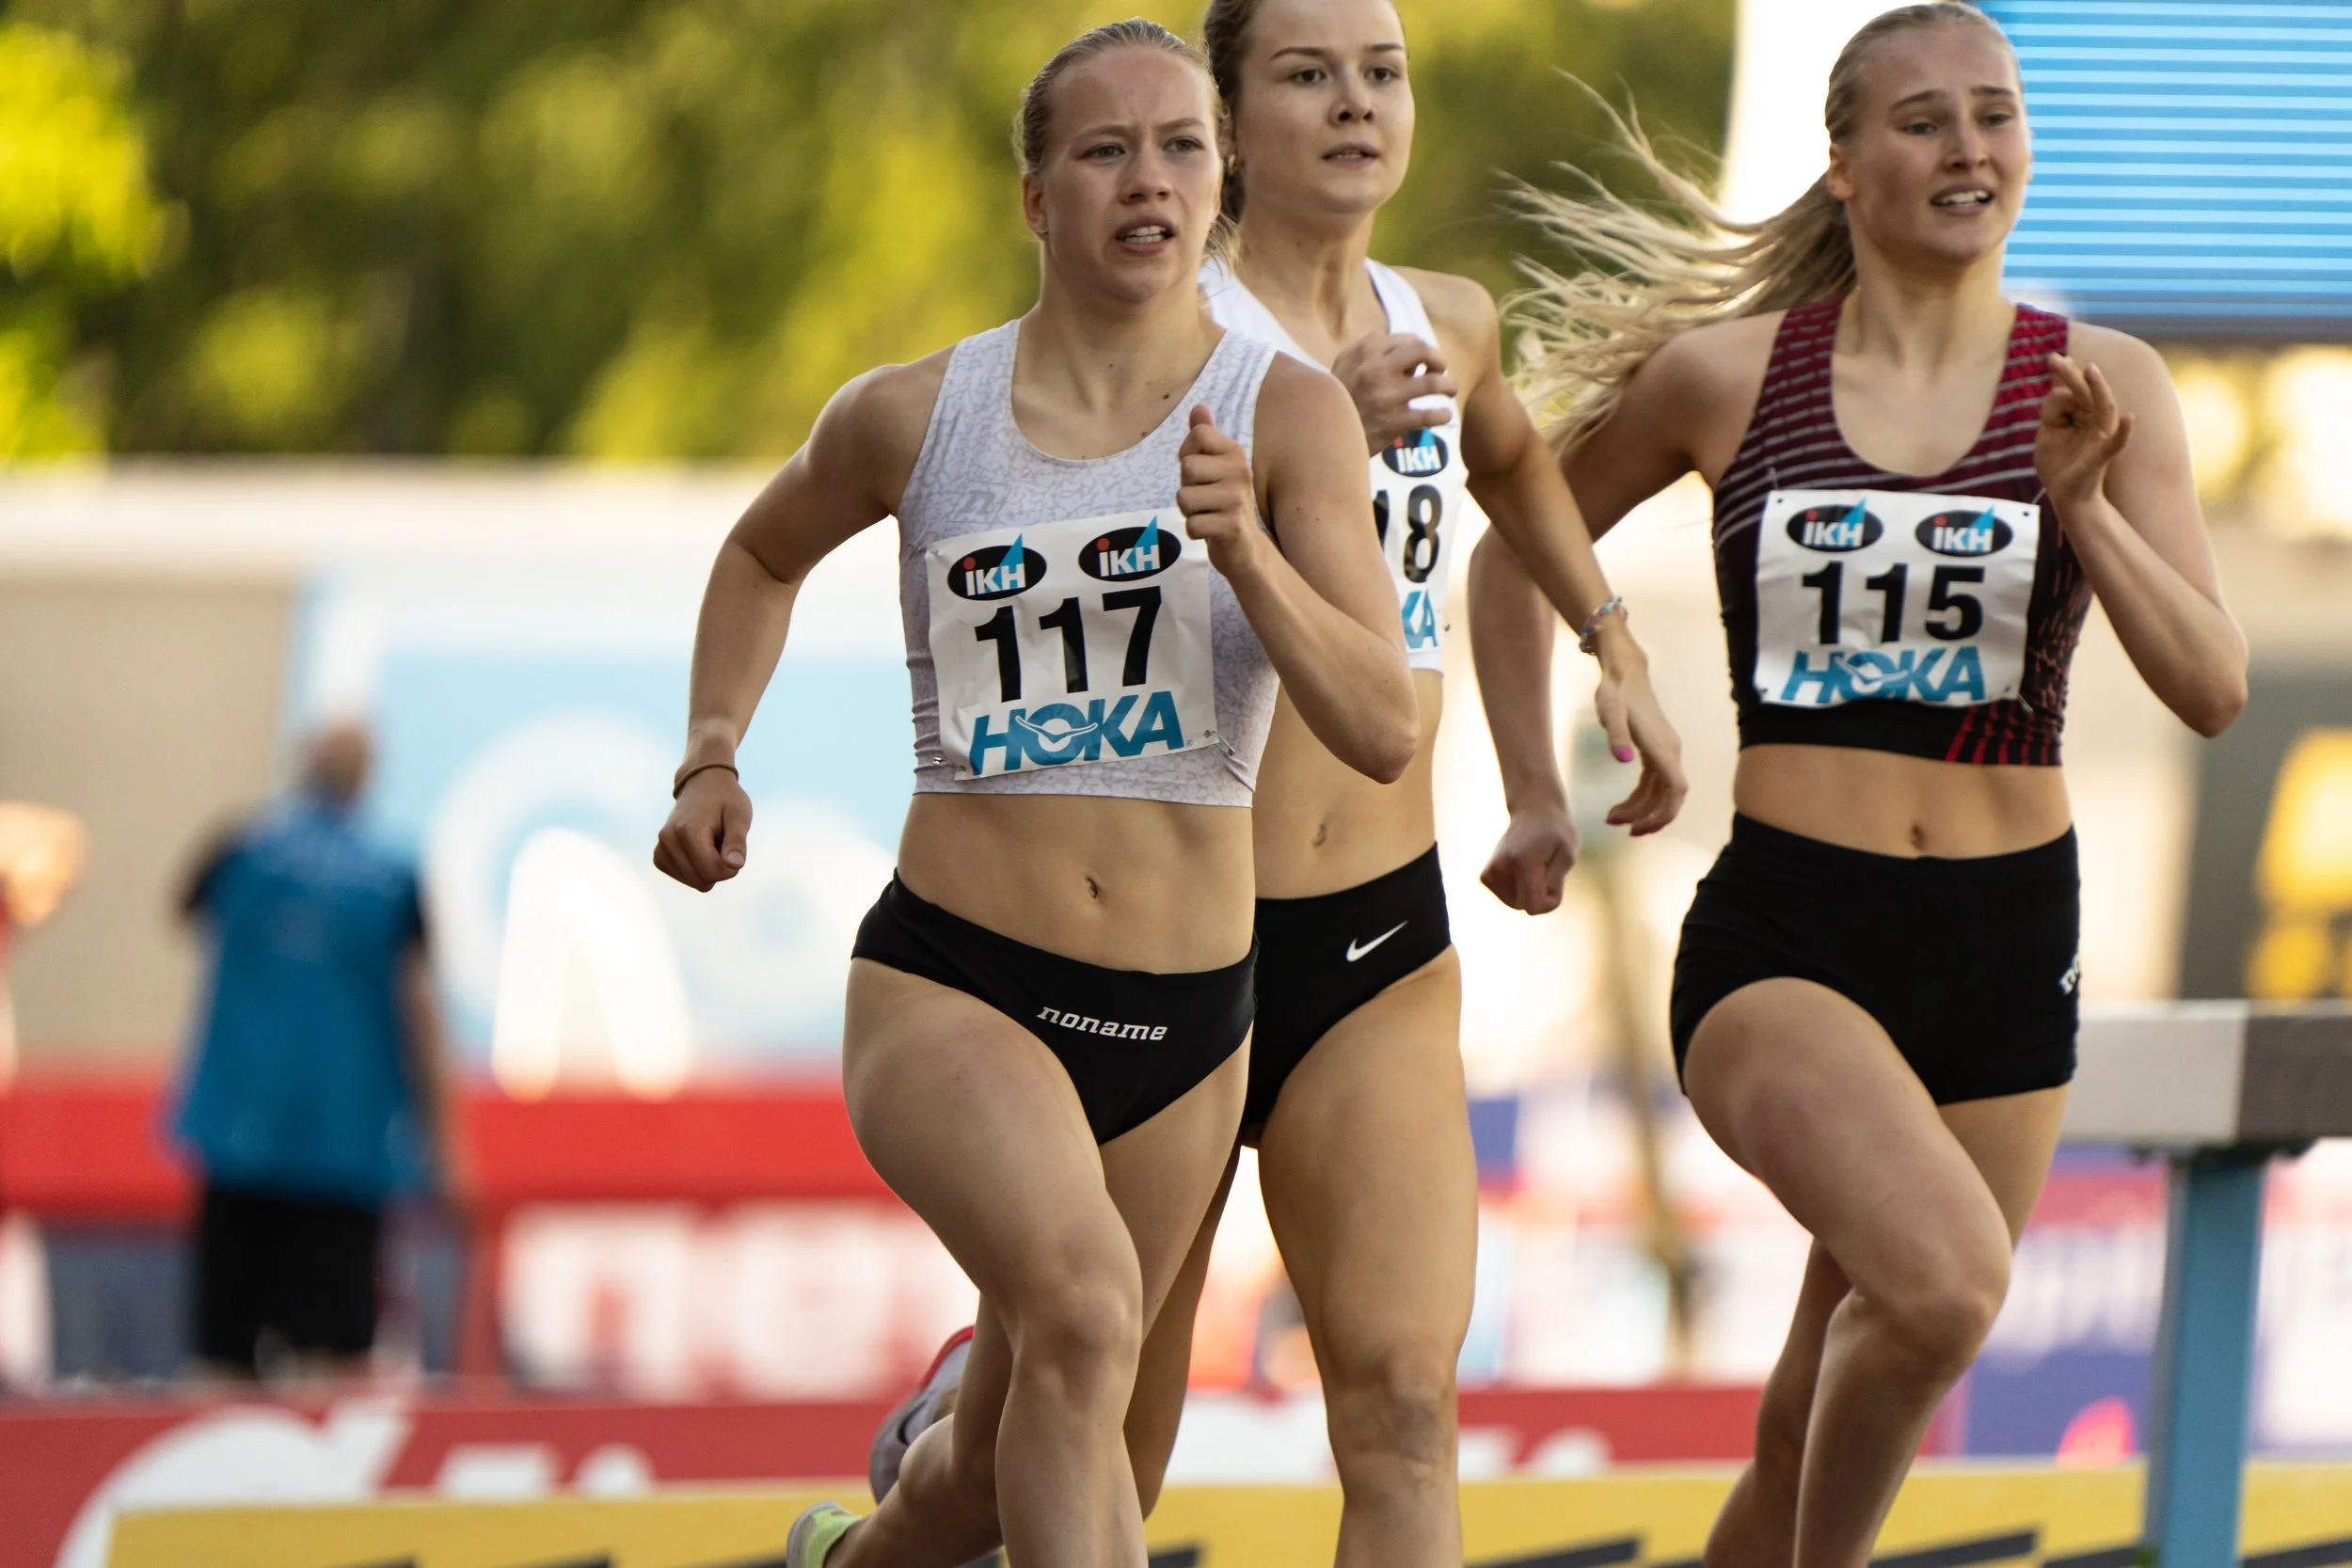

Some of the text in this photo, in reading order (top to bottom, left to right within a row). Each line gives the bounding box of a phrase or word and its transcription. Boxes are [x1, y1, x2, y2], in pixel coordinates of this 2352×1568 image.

[974, 585, 1162, 704] 117
[1802, 560, 1985, 645] 115
[1780, 646, 1986, 704] HOKA
[969, 690, 1185, 776] HOKA
[1037, 1006, 1168, 1041] noname
